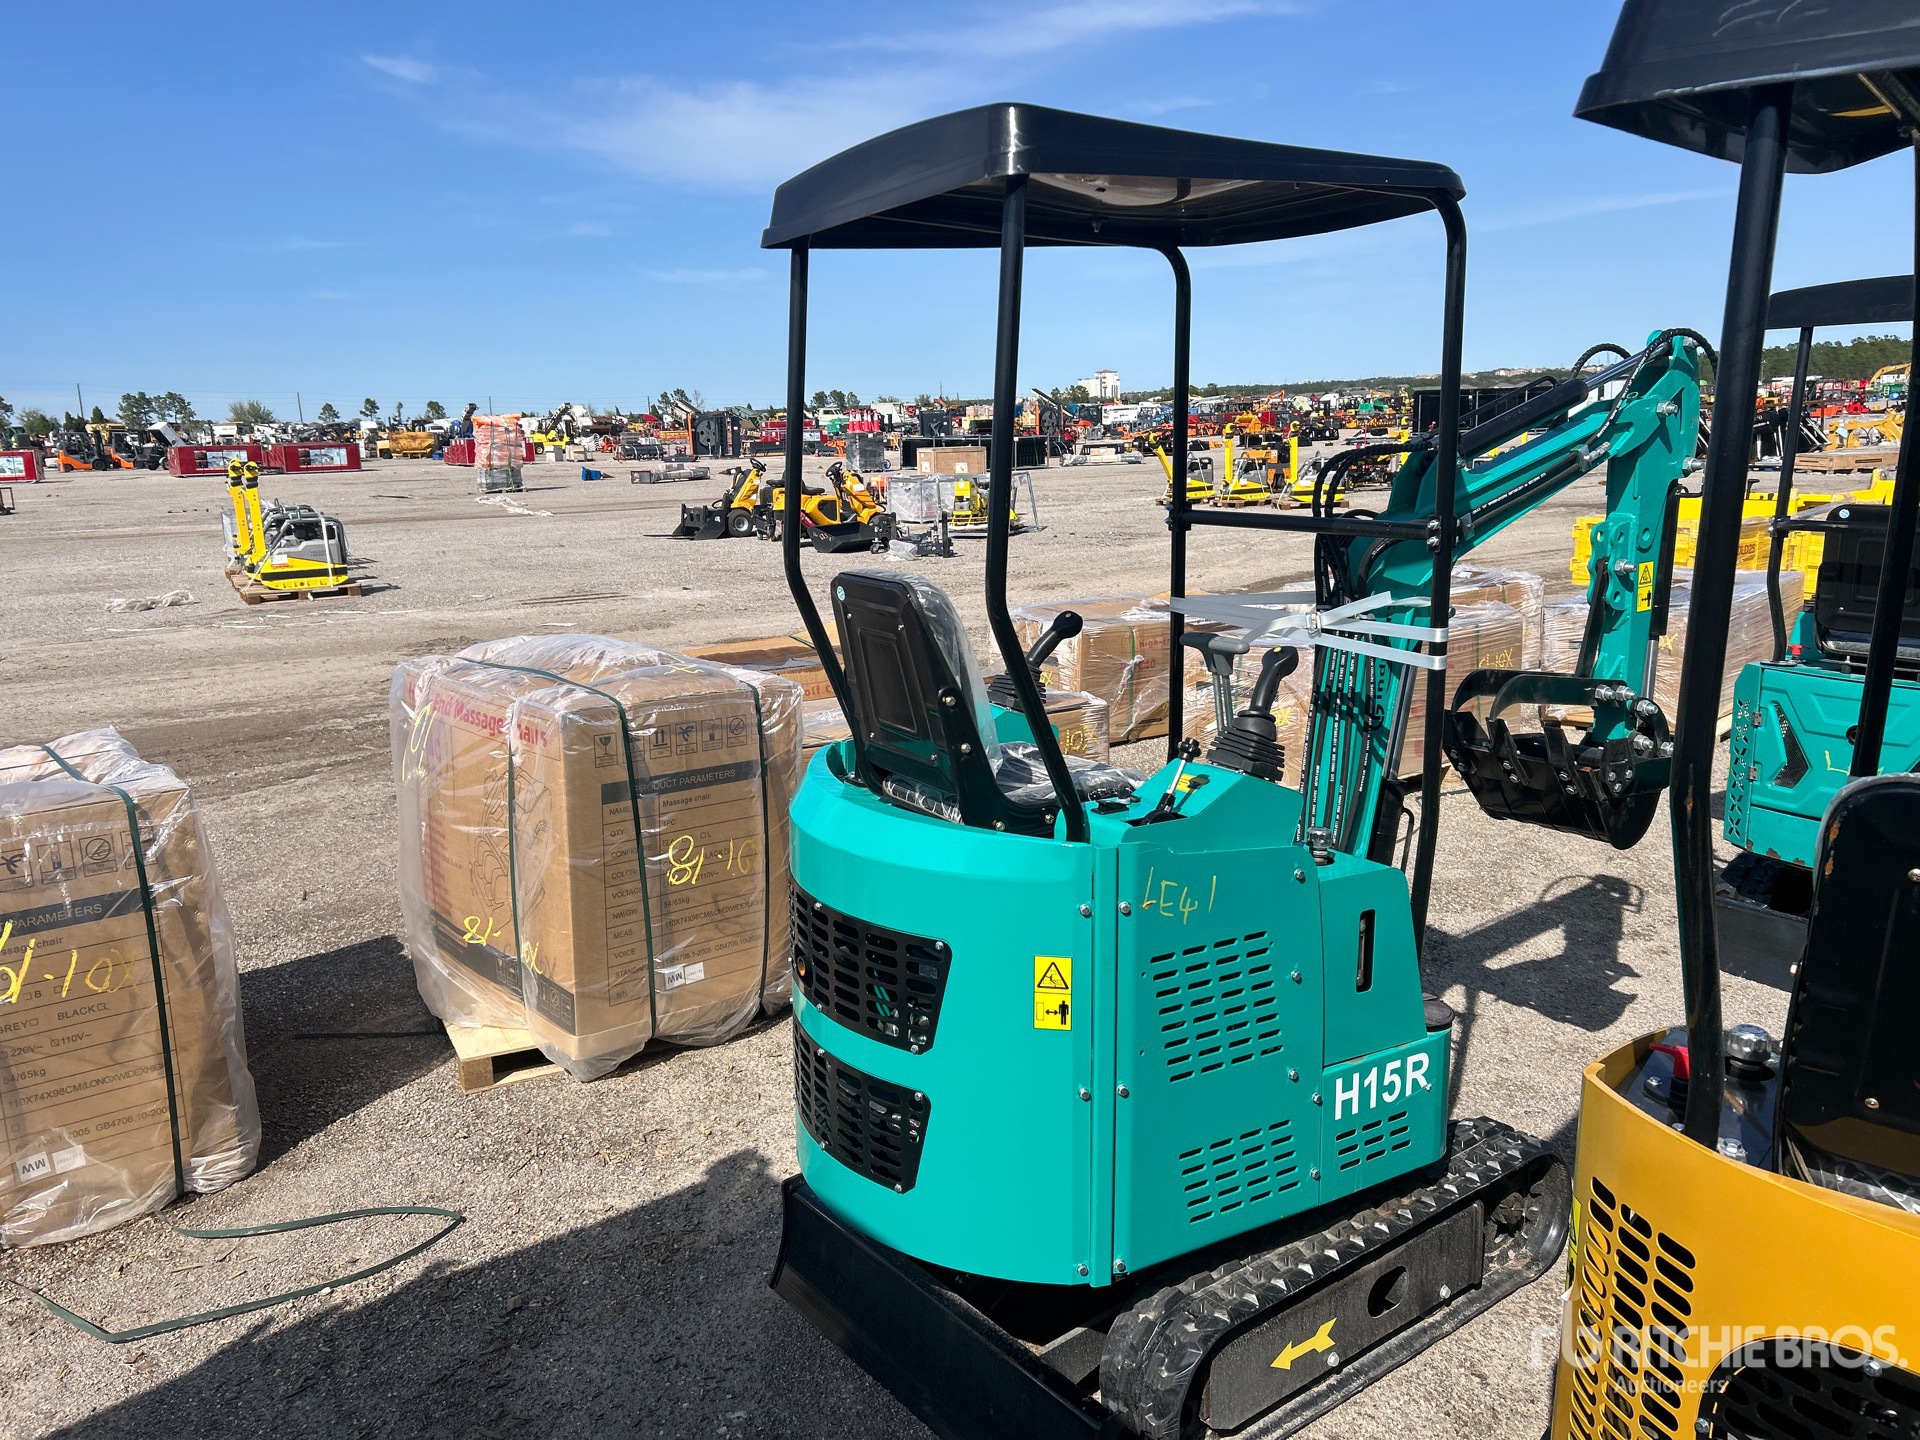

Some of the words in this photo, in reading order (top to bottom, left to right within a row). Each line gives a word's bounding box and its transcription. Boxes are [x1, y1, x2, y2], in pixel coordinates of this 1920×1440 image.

[804, 686, 820, 696] olf
[680, 769, 736, 785] PARAMETERS
[609, 806, 629, 815] NAME
[663, 797, 692, 807] Massage
[694, 793, 711, 802] chair
[610, 829, 625, 837] QTY
[12, 903, 103, 929] PARAMETERS
[613, 929, 634, 939] MEAS
[37, 937, 63, 949] chair
[614, 948, 636, 959] VOICE
[57, 1006, 95, 1020] BLACK
[1335, 1052, 1430, 1119] H15R
